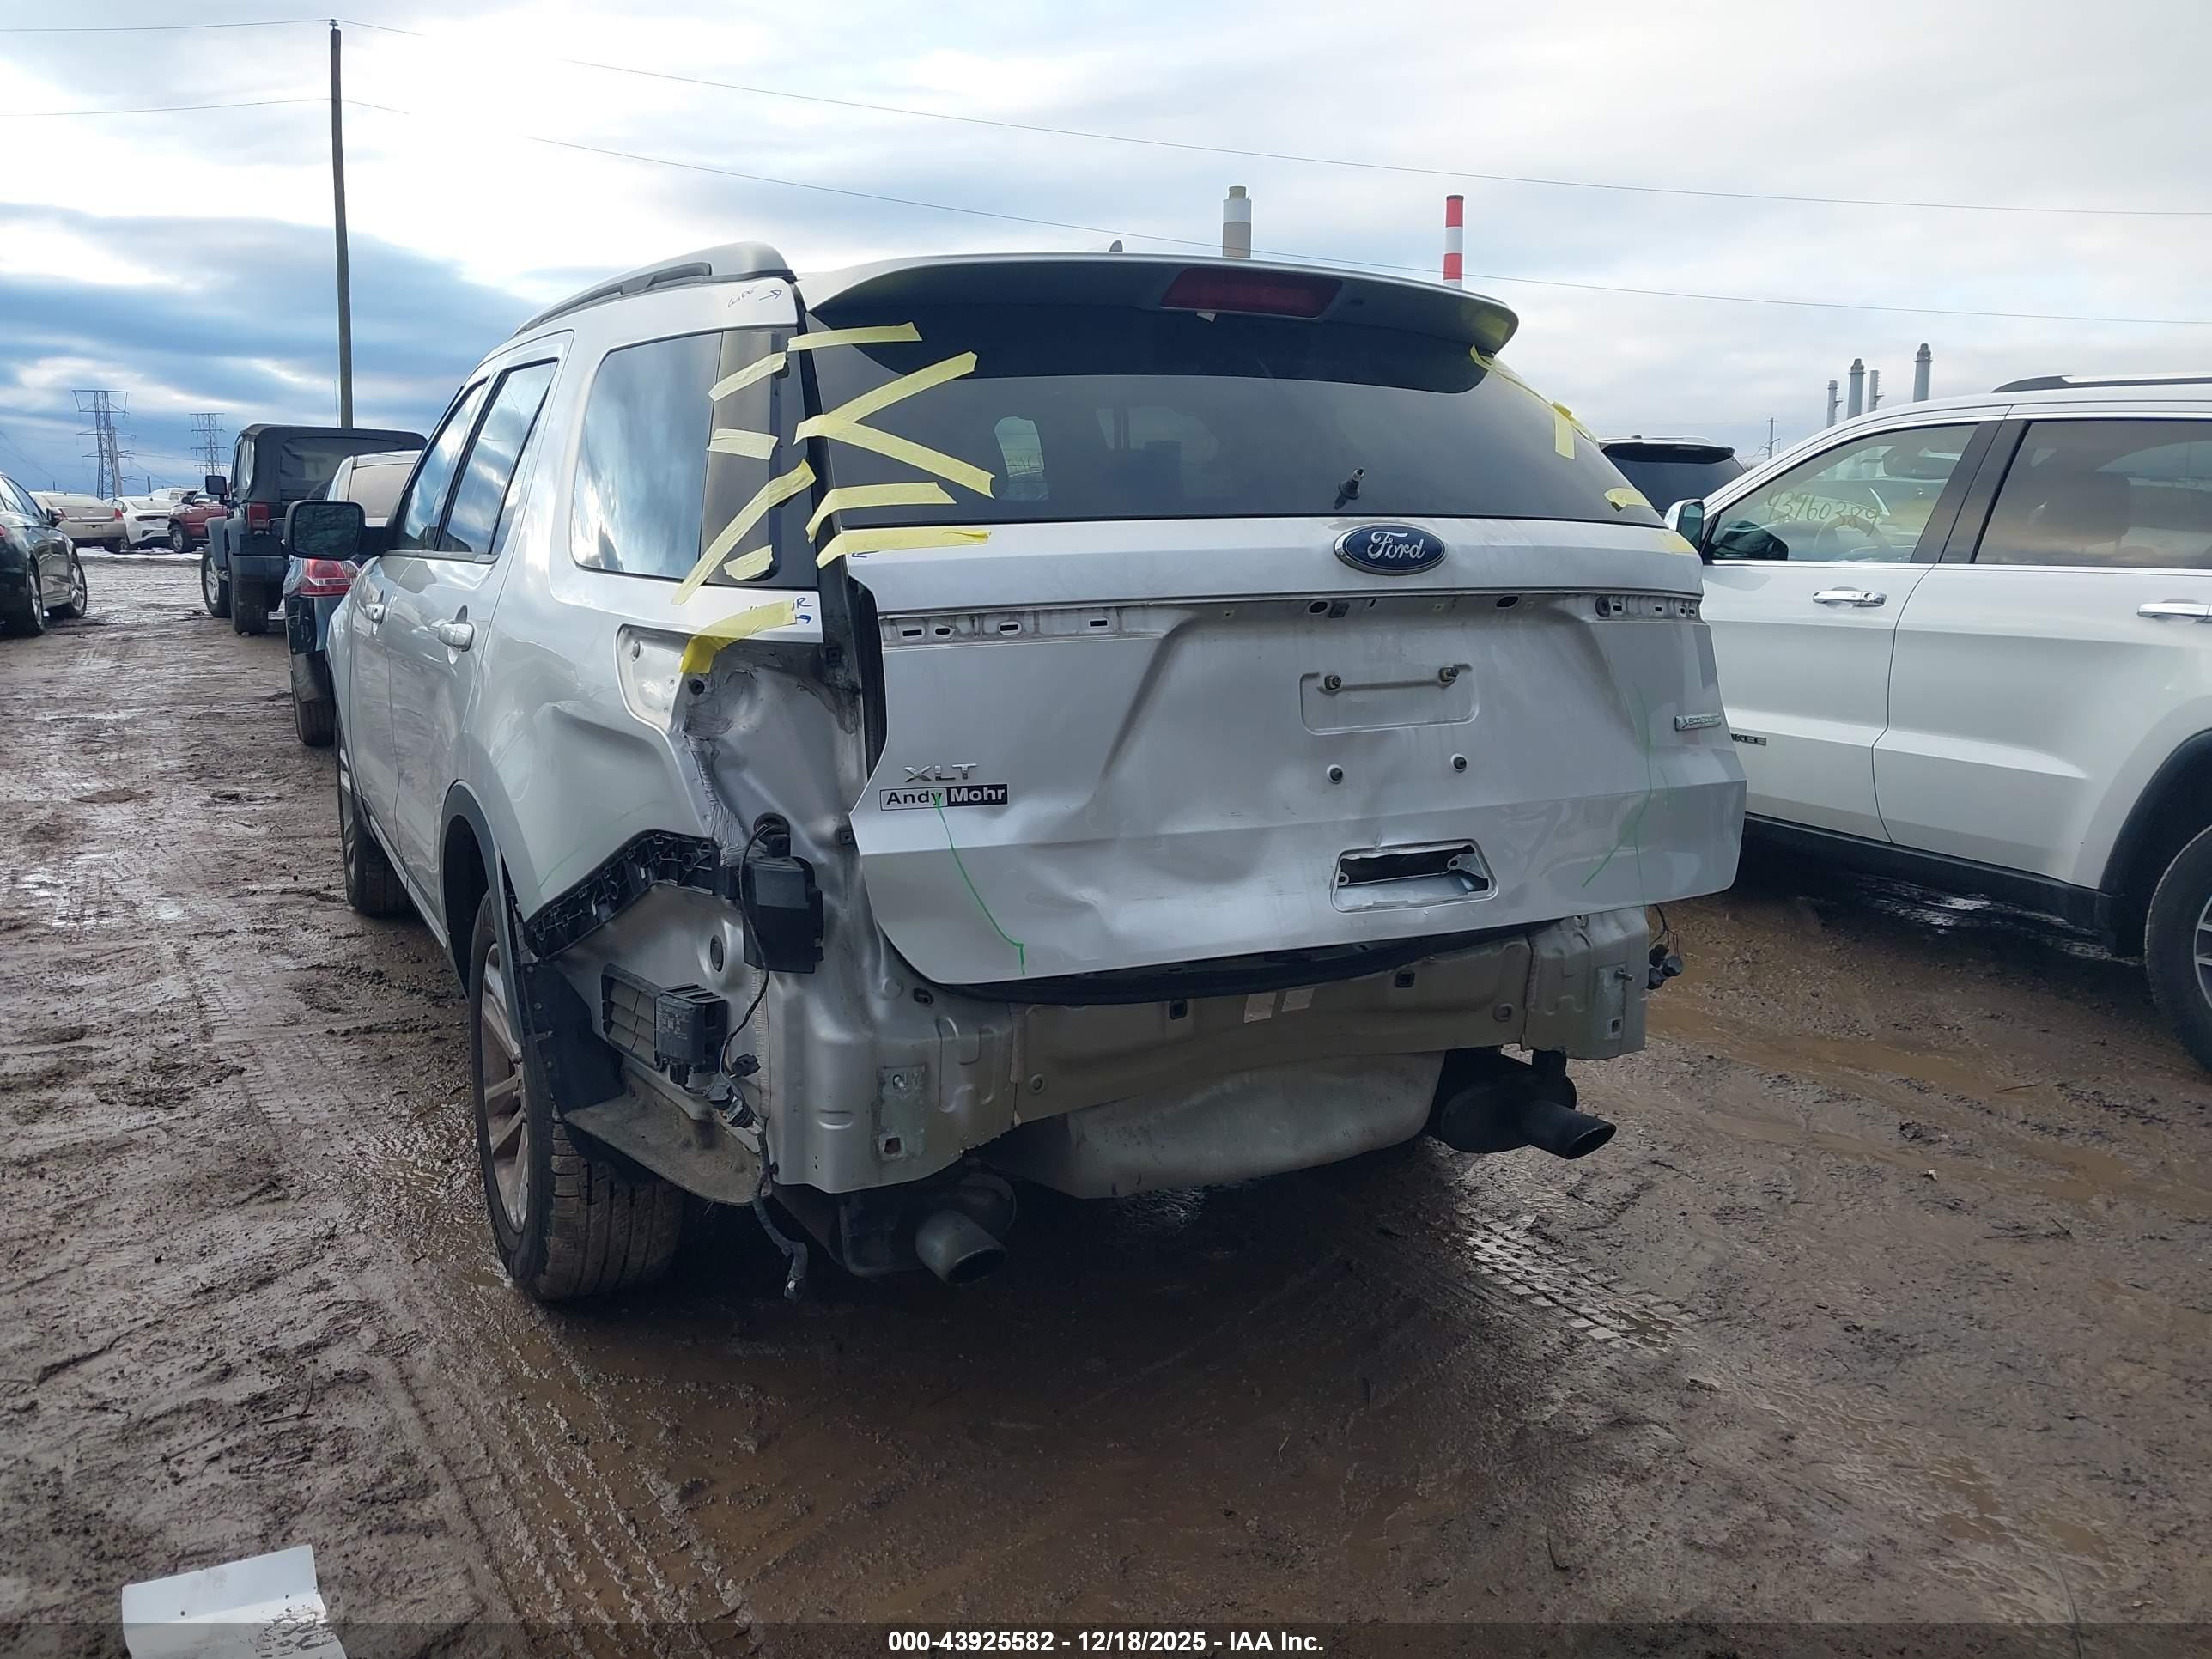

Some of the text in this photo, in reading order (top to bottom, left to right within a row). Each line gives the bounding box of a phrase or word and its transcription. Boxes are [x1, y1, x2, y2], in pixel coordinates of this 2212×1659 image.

[1367, 531, 1425, 559] Ford
[904, 763, 978, 782] XLT
[886, 787, 1006, 806] Andy Mohr
